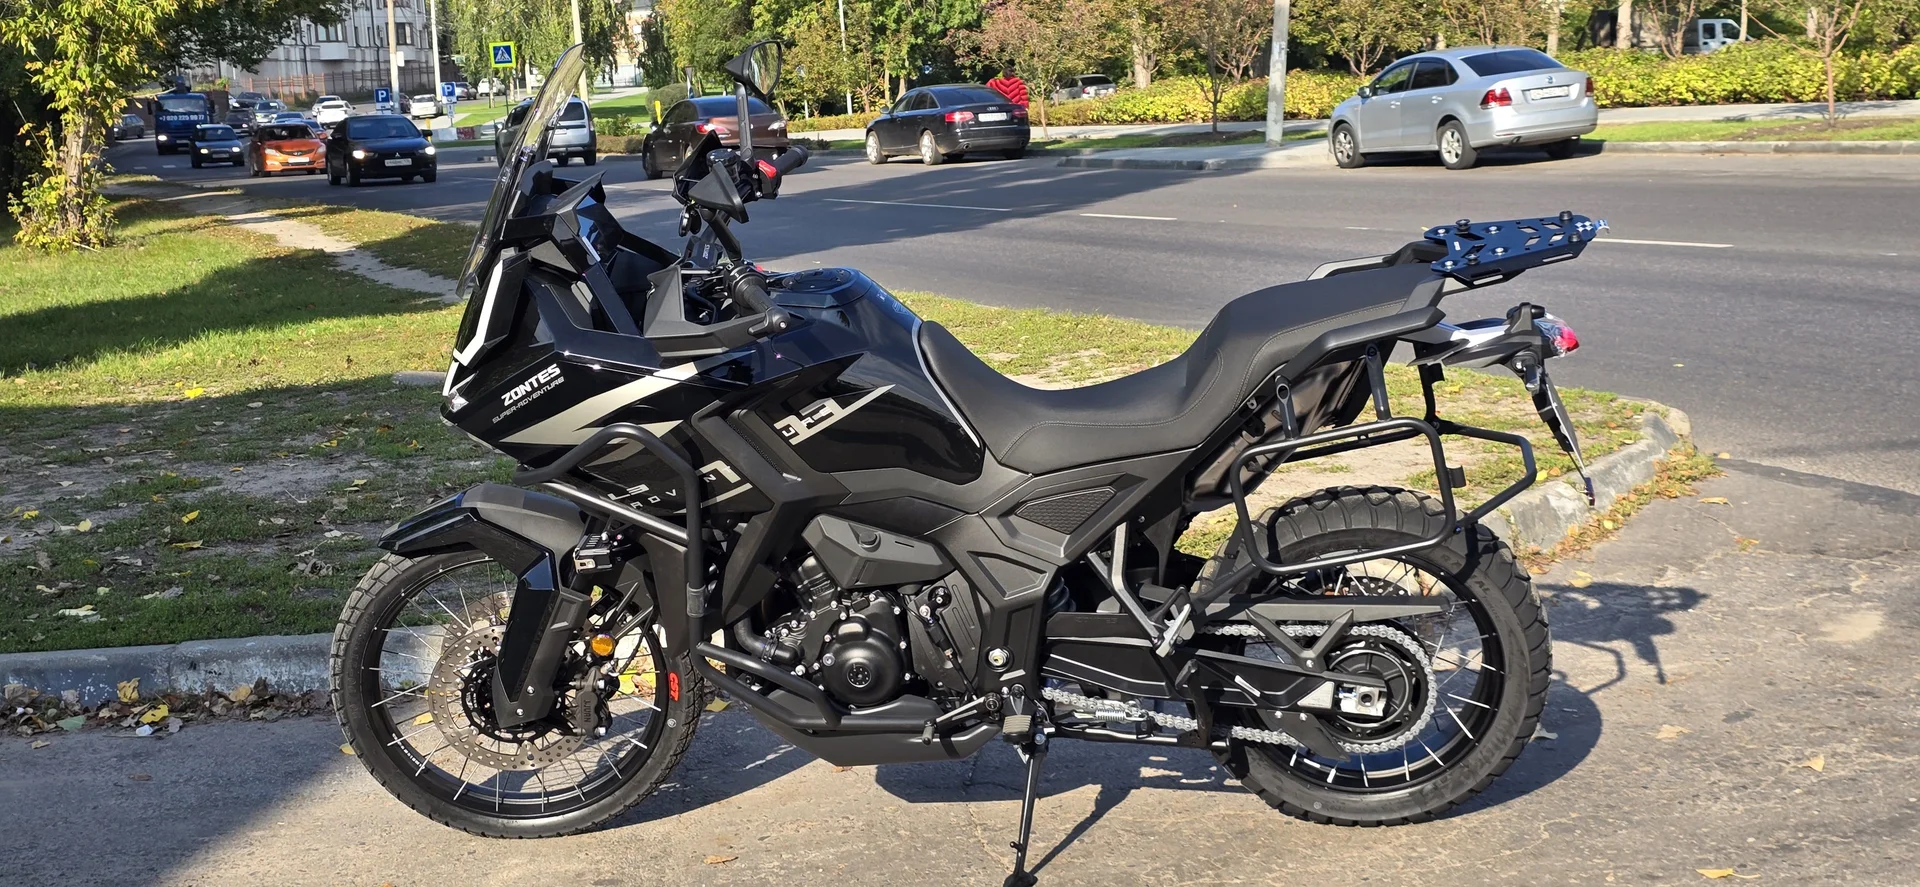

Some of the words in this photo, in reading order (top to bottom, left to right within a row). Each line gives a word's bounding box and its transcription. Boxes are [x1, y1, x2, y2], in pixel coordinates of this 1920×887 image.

[378, 90, 387, 102] P
[444, 84, 453, 96] P
[492, 376, 565, 424] SUPER-ADVENTURE
[501, 363, 561, 407] ZONTES
[669, 672, 679, 702] CST
